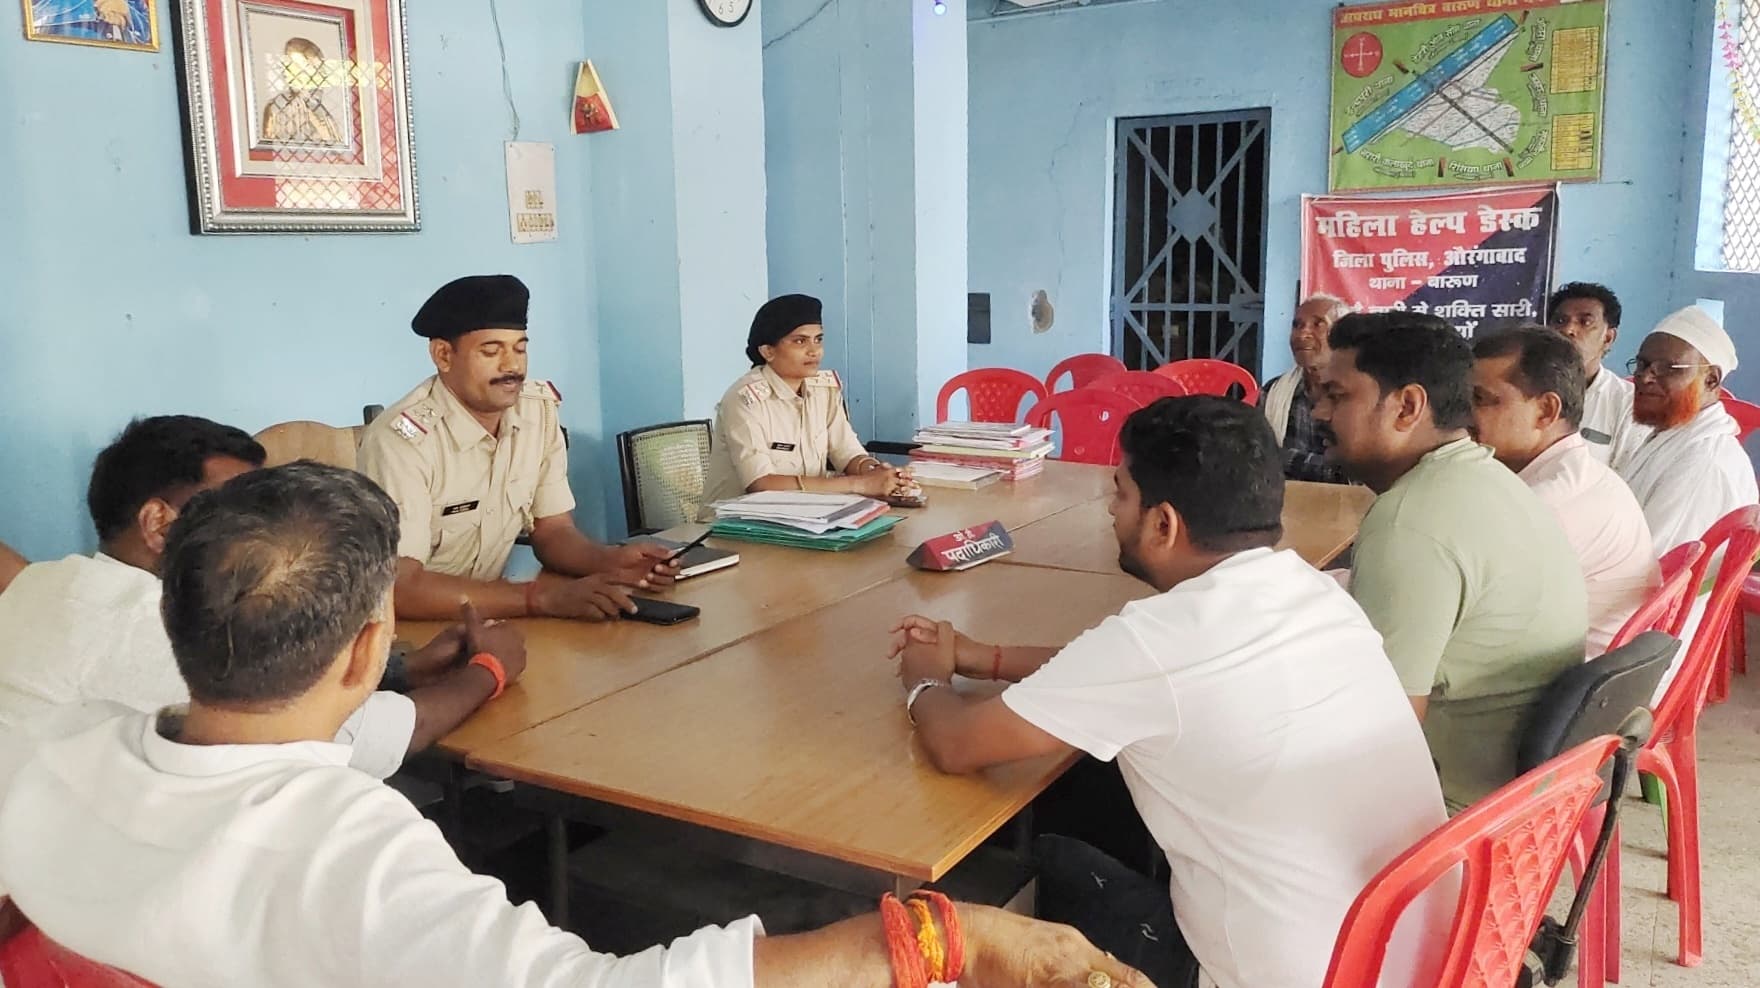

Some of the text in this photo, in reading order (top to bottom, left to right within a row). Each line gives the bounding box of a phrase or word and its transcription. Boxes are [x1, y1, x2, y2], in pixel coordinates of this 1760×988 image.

[1316, 205, 1543, 238] महिला हेल्प डेस्क
[1332, 245, 1527, 272] जिला पुलिस, औरंगाबाद
[1368, 276, 1405, 290] थाना
[1427, 274, 1479, 290] बारूण
[1433, 299, 1487, 318] शक्ति
[940, 531, 1005, 563] पदाधिकारी
